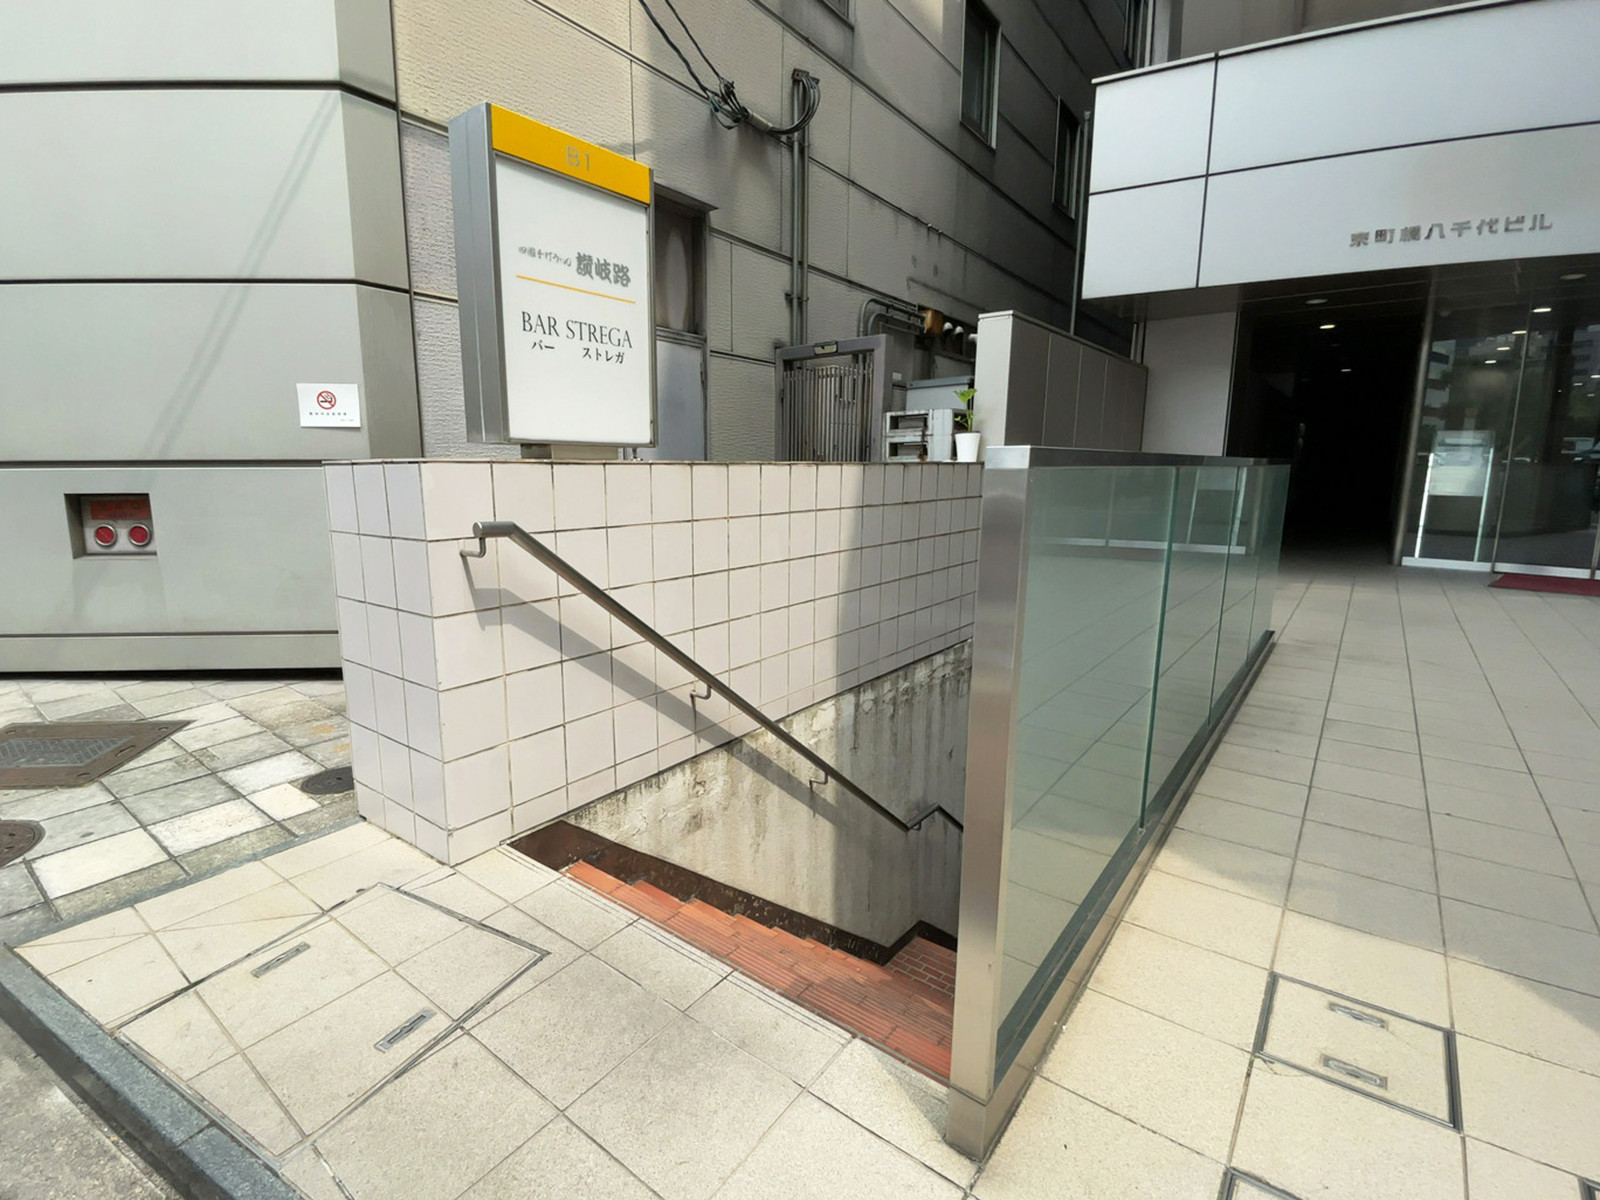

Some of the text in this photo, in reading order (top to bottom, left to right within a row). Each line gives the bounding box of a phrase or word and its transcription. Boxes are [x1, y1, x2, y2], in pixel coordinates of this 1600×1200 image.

[567, 145, 591, 171] B1
[521, 311, 633, 349] BAR STREGA
[531, 340, 625, 365] バー ストレガ
